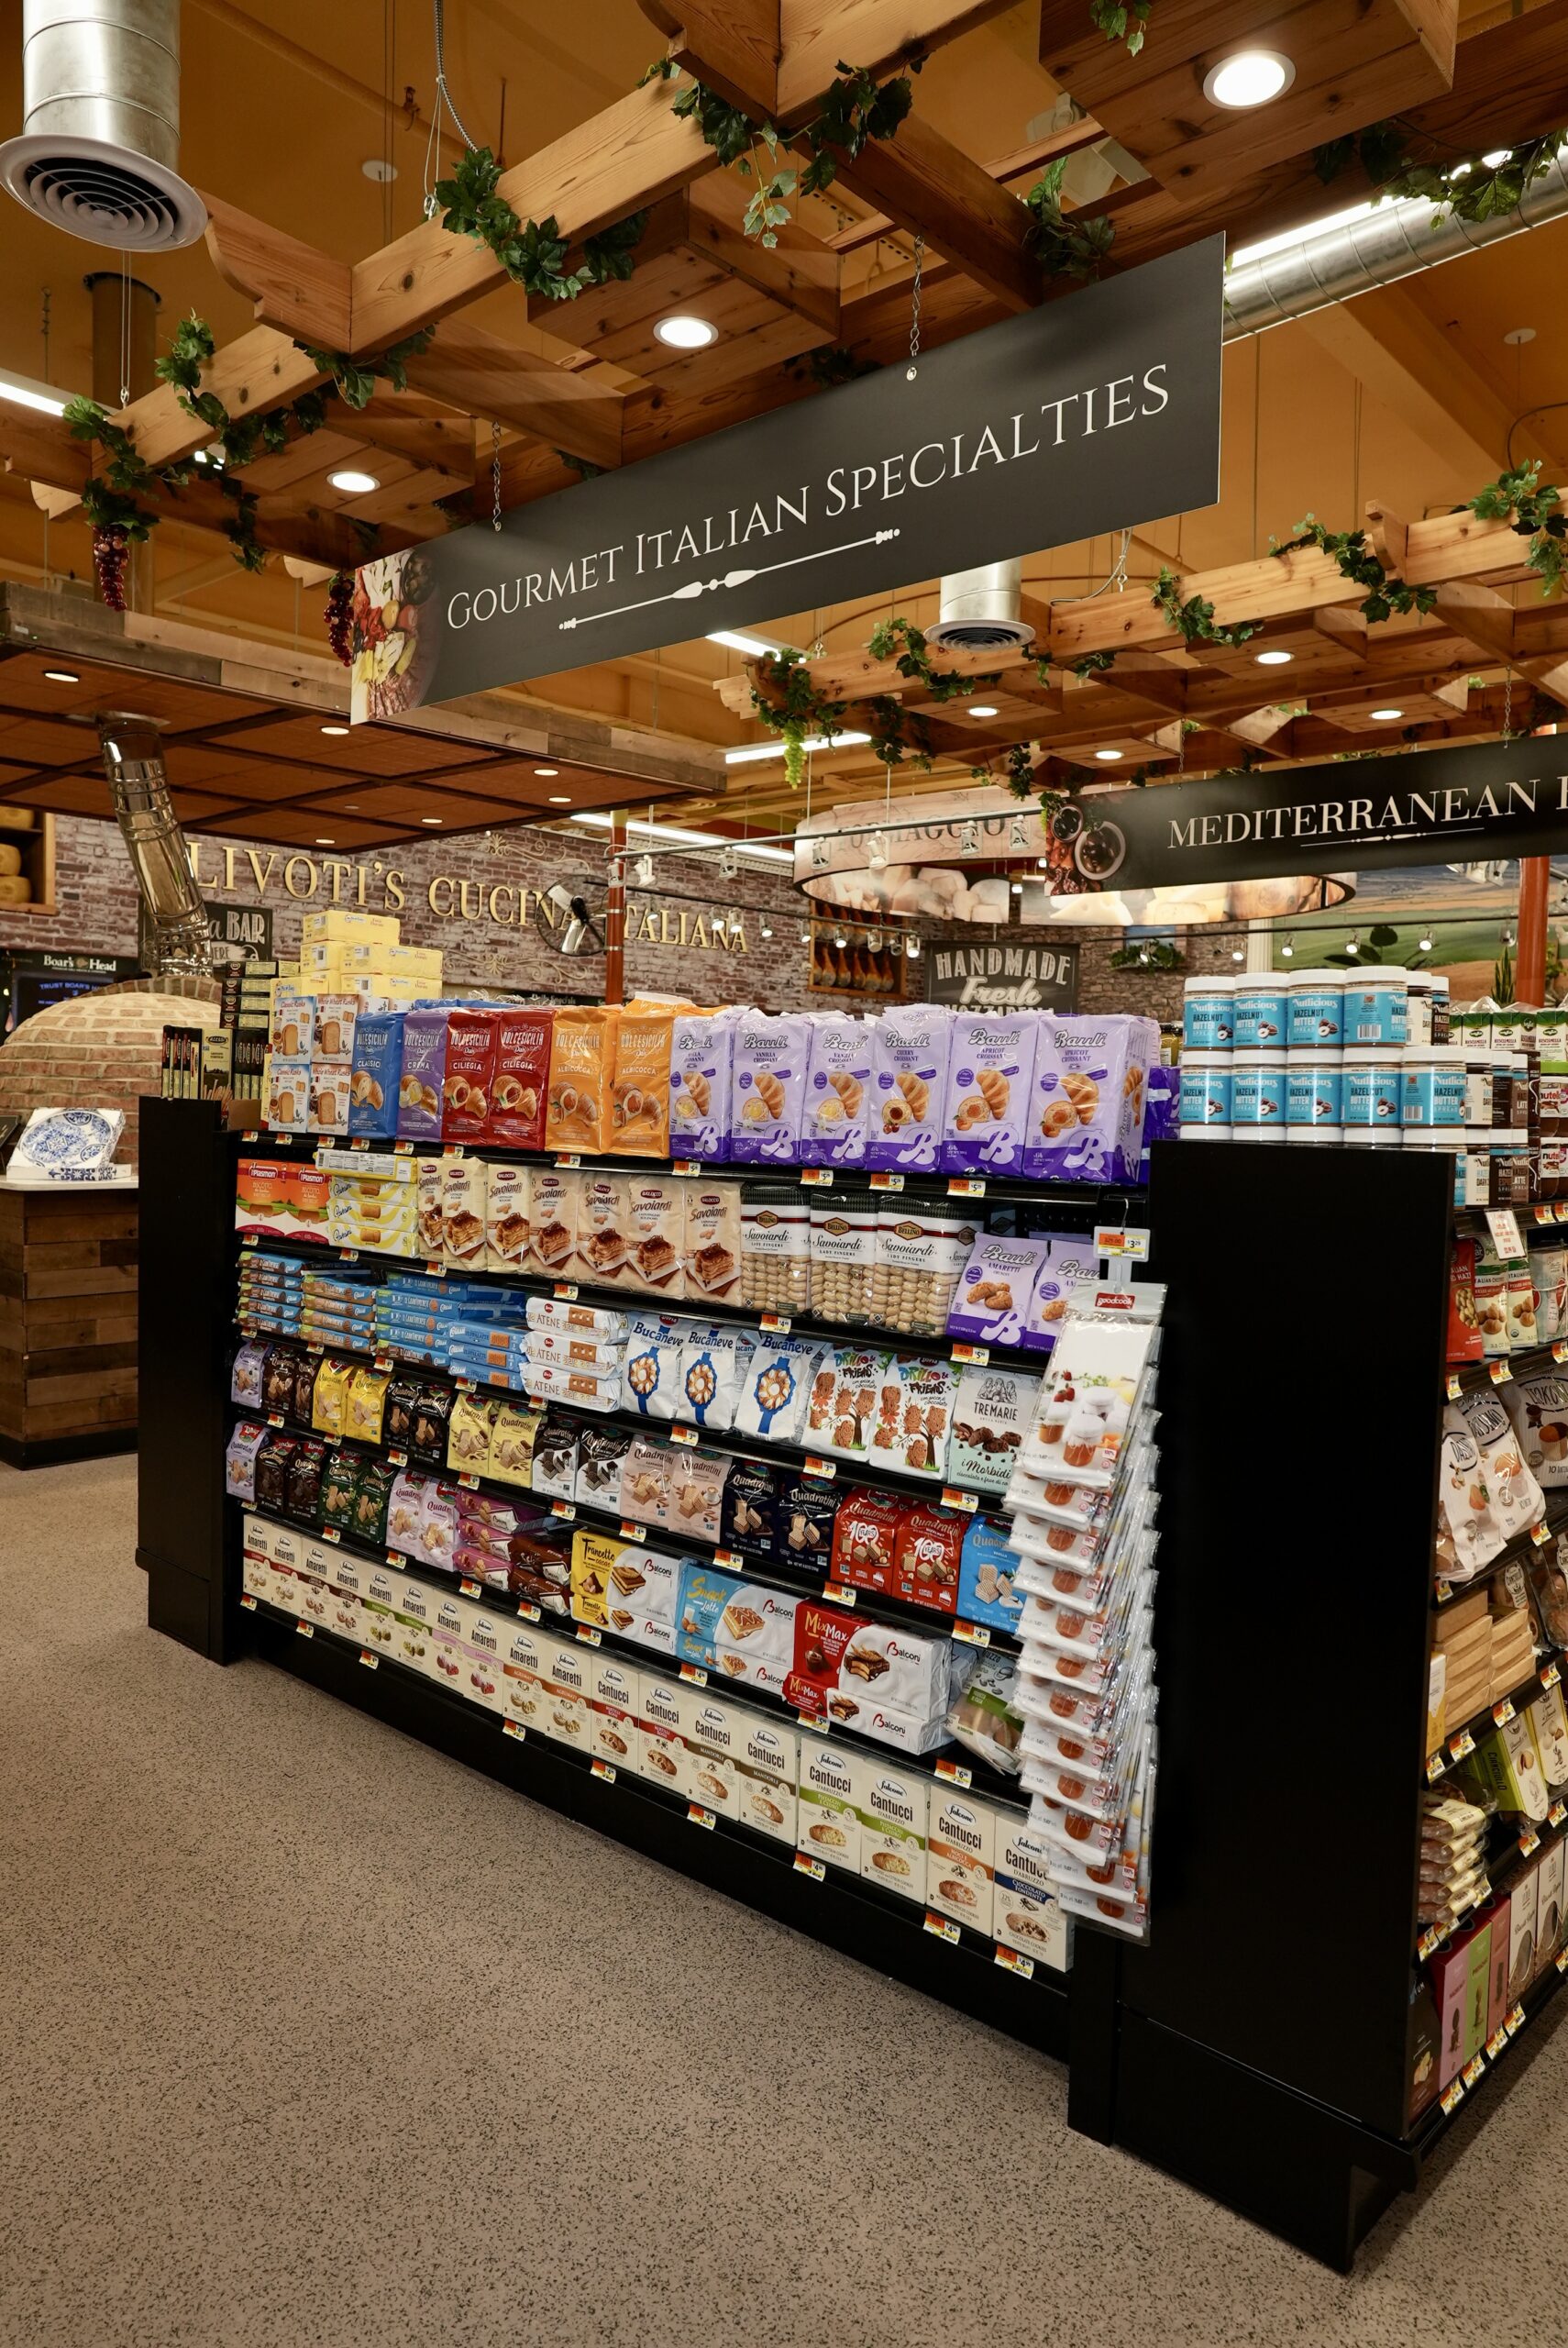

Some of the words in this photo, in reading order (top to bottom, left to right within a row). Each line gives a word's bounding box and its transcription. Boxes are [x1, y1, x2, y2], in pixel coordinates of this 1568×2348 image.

[447, 545, 624, 632] GOURMET
[635, 485, 811, 575] ITALIAN
[824, 363, 1171, 517] SPECIALTIES
[1167, 779, 1540, 849] MEDITERRANEAN
[226, 911, 265, 944] BAR
[624, 904, 747, 953] TALIANA
[44, 955, 73, 968] Boar's
[90, 958, 116, 971] Head
[935, 947, 1071, 985] HANDMADE
[960, 976, 1042, 1006] Fresh
[1292, 998, 1338, 1009] Nutlicious
[1193, 1013, 1223, 1022] HAZELNUT
[1294, 1009, 1324, 1017] HAZELNUT
[744, 1034, 789, 1049] Bauli
[823, 1034, 868, 1050] Bauli
[885, 1032, 931, 1048] Bauli
[968, 1028, 1021, 1047] Bauli
[1055, 1029, 1107, 1048] Bauli
[453, 1062, 481, 1071] CILIEGIA
[502, 1061, 533, 1069] CILIEGIA
[1434, 1088, 1463, 1096] HAZELNUT
[443, 1181, 470, 1195] Savoiardi
[490, 1183, 522, 1199] Savoiardi
[533, 1189, 568, 1202] Savoiardi
[585, 1194, 621, 1207] Savoiardi
[690, 1207, 727, 1223] Savoiardi
[745, 1228, 789, 1241] Savoiardi
[812, 1236, 863, 1250] Savoiardi
[882, 1239, 933, 1256] Savoiardi
[980, 1245, 1037, 1265] Bauli
[988, 1263, 1021, 1273] AMARETTI
[536, 1314, 560, 1329] ATENE
[633, 1321, 683, 1346] Bucaneve
[688, 1331, 734, 1348] Bucaneve
[762, 1335, 812, 1355] Bucaneve
[536, 1351, 560, 1363] ATENE
[534, 1381, 559, 1396] ATENE
[974, 1401, 1018, 1421] TREMARIE
[501, 1417, 533, 1432] Quadratini
[635, 1449, 674, 1465] Quadratini
[682, 1460, 721, 1477] Quadratini
[966, 1460, 1010, 1479] Morbidi
[733, 1474, 775, 1493] Quadratini
[790, 1489, 837, 1508] Quadratini
[850, 1501, 898, 1523] Quadratini
[248, 1534, 268, 1551] Amaretti
[581, 1537, 615, 1562] Trancetto
[274, 1546, 295, 1563] Amaretti
[305, 1558, 326, 1575] Amaretti
[644, 1558, 672, 1577] Balconi
[337, 1571, 359, 1589] Amaretti
[370, 1584, 392, 1601] Amaretti
[687, 1576, 727, 1603] Snack
[403, 1598, 426, 1617] Amaretti
[762, 1599, 794, 1618] Balconi
[437, 1613, 460, 1633] Amaretti
[644, 1621, 670, 1639] Balconi
[471, 1630, 497, 1651] Amaretti
[510, 1647, 538, 1668] Amaretti
[886, 1641, 921, 1663] Balconi
[552, 1666, 582, 1687] Amaretti
[598, 1681, 628, 1704] Cantucci
[646, 1700, 679, 1724] Cantucci
[703, 1709, 723, 1723] falcone
[695, 1720, 731, 1745] Cantucci
[872, 1713, 906, 1735] Balconi
[756, 1731, 777, 1746] falcone
[747, 1743, 785, 1769] Cantucci
[819, 1754, 844, 1768] falcone
[753, 1770, 778, 1785] MANDORLE
[810, 1765, 851, 1794] Cantucci
[880, 1780, 903, 1796] falcone
[871, 1792, 913, 1822] Cantucci
[950, 1805, 973, 1823] falcone
[939, 1817, 981, 1849] Cantucci
[1012, 1879, 1045, 1898] CIOCCOLATO
[1015, 1885, 1043, 1901] FONDENTE
